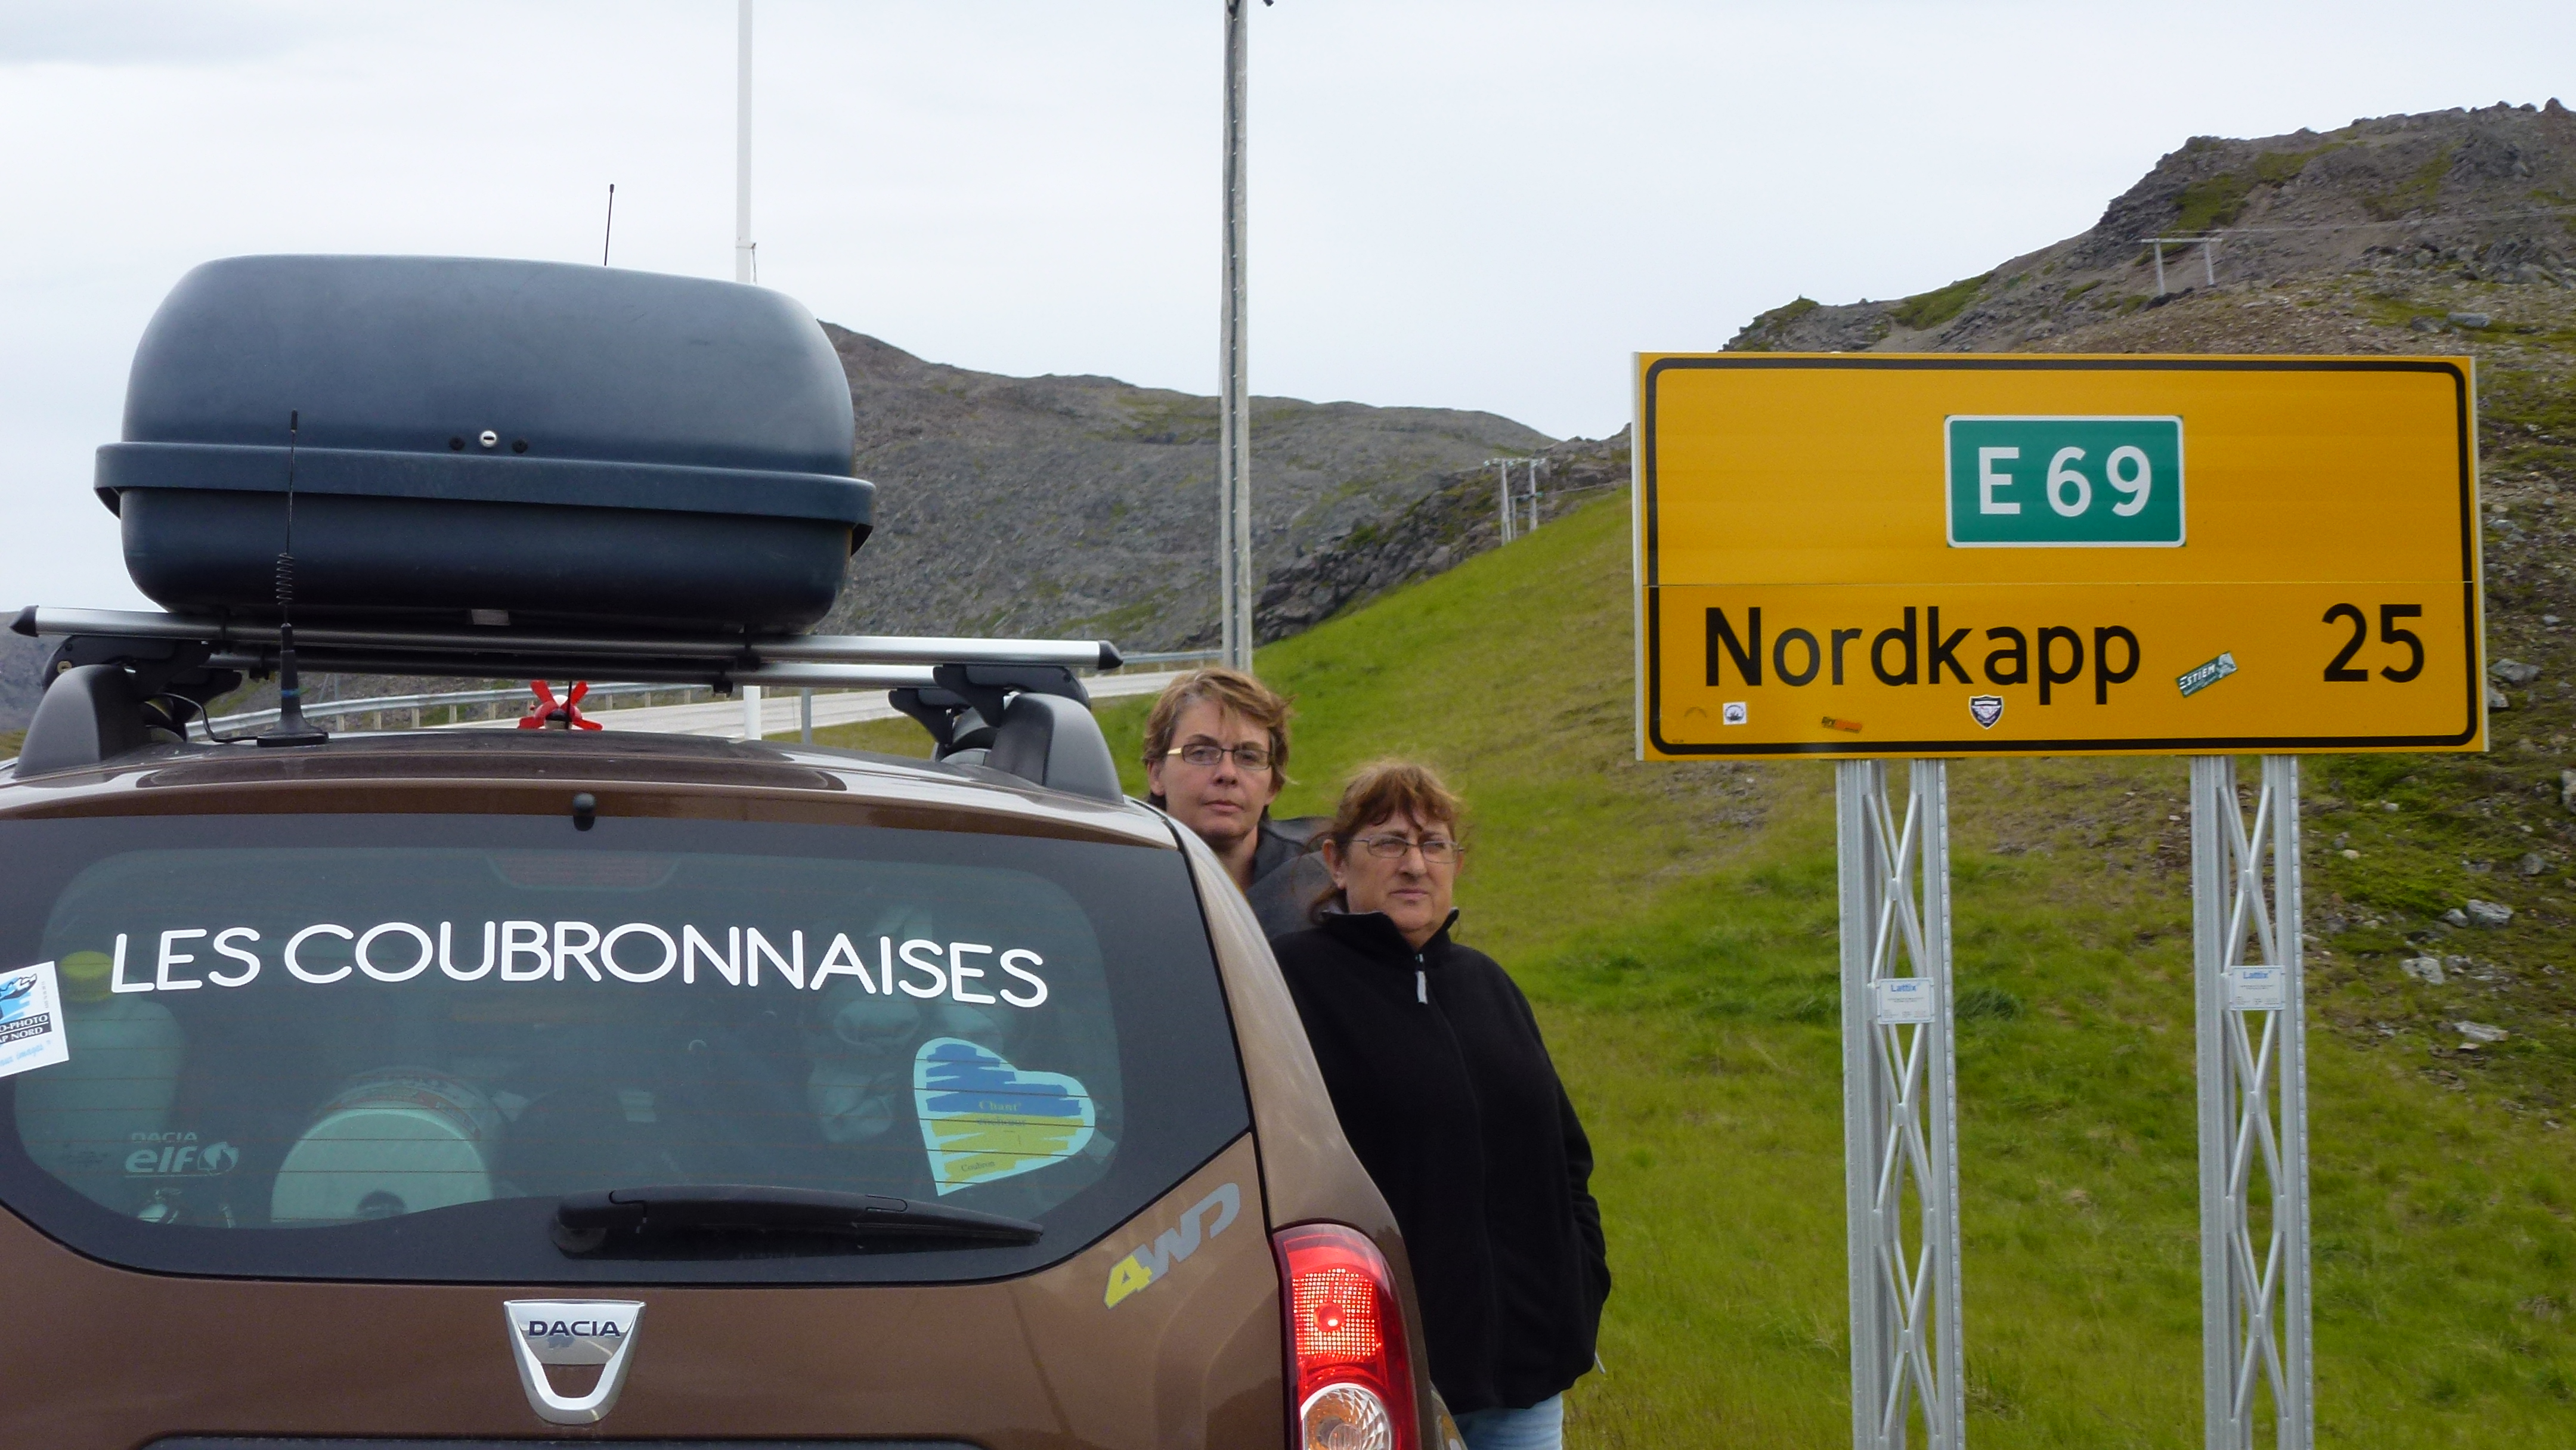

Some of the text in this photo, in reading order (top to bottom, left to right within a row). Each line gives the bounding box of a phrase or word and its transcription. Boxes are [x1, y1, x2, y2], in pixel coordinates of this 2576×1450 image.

[1979, 445, 2151, 517] E 69
[1706, 603, 2425, 705] Nordkapp 25
[112, 921, 1048, 1008] LES COUBRONNAISES
[11, 1027, 43, 1040] NORD
[125, 1145, 199, 1173] elf
[1104, 1182, 1241, 1310] 4WD
[528, 1321, 621, 1337] DACIA
